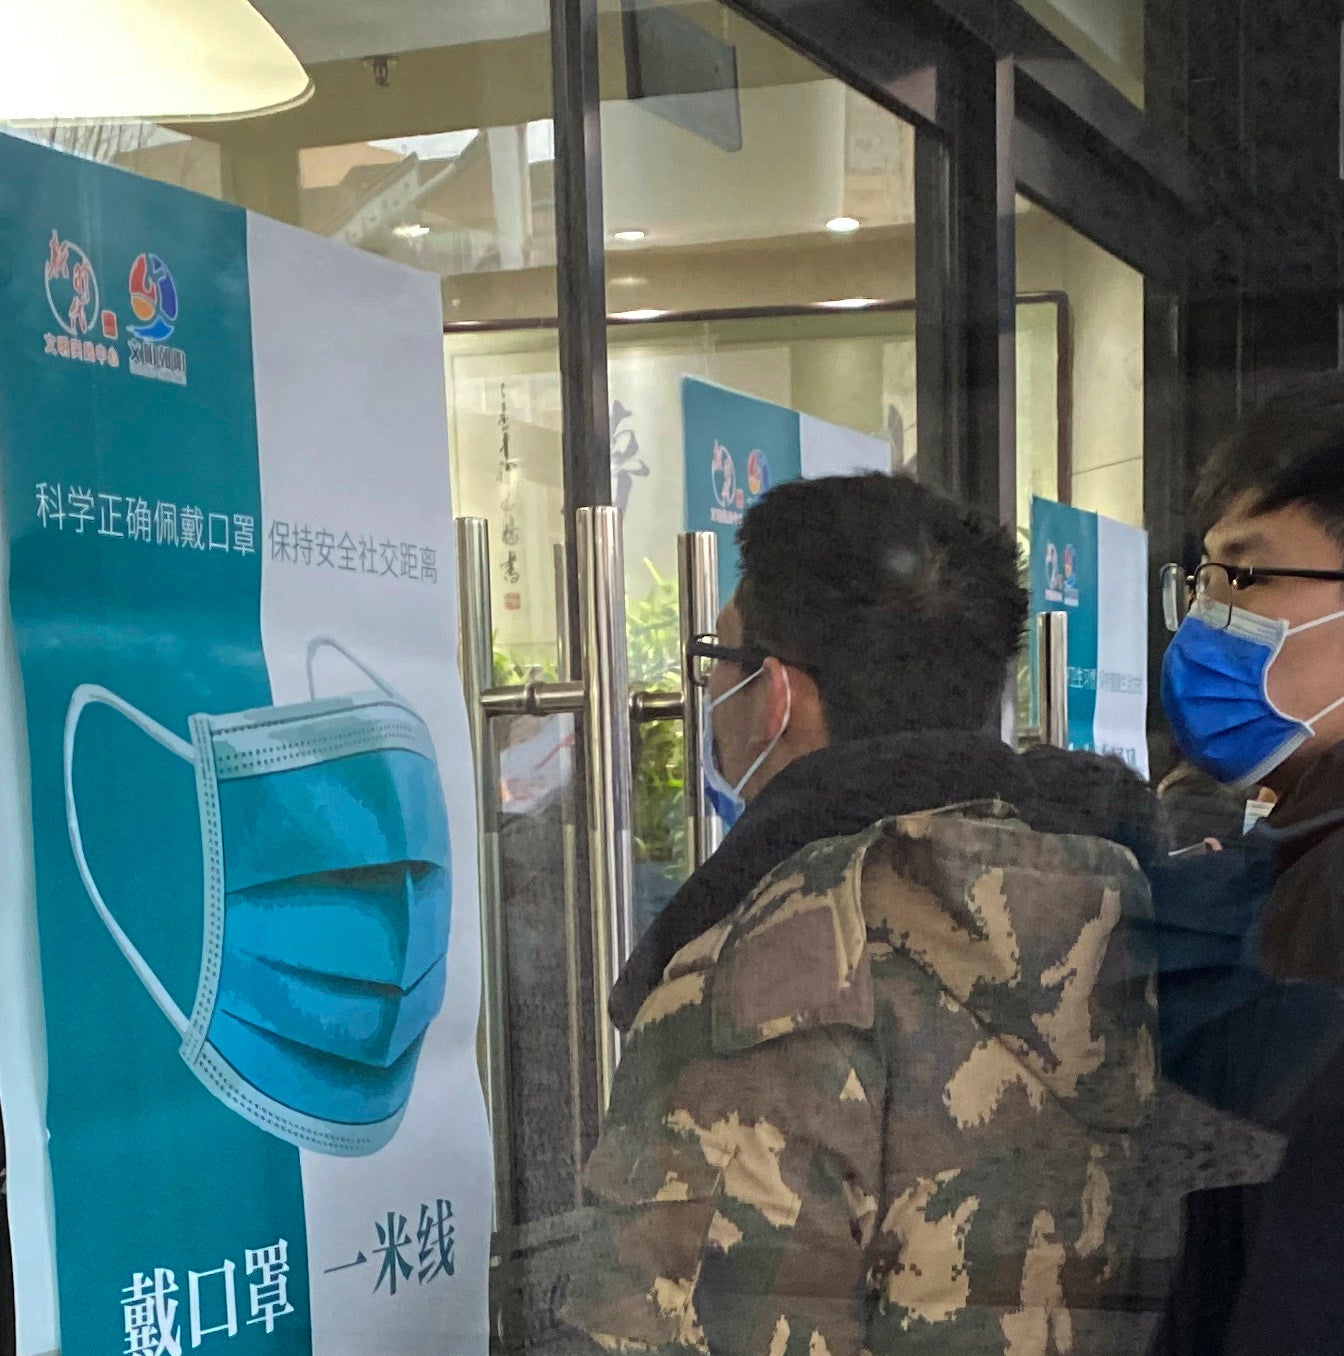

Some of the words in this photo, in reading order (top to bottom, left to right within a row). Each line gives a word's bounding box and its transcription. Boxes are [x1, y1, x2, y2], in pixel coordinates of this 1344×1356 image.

[35, 482, 256, 556] 科学正确佩戴口罩
[267, 518, 439, 584] 保持安全社交距离
[323, 1198, 457, 1297] 一米线
